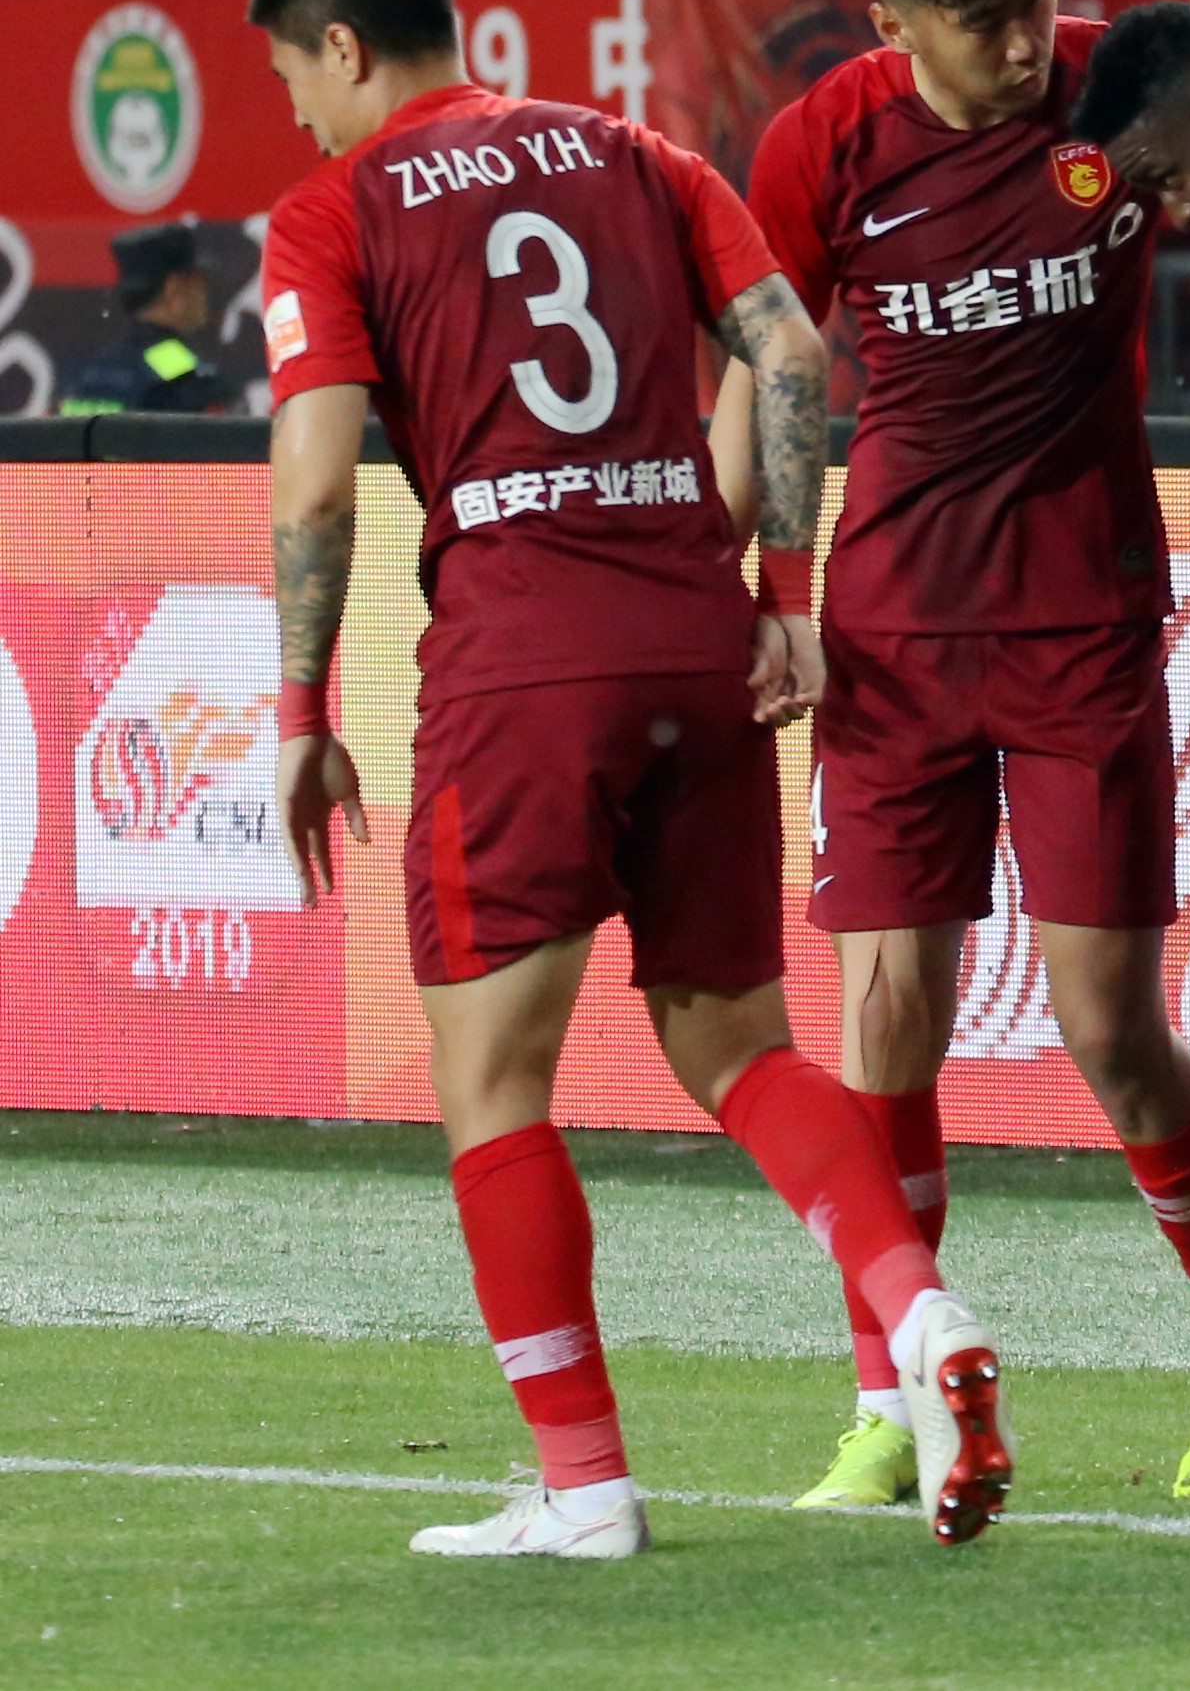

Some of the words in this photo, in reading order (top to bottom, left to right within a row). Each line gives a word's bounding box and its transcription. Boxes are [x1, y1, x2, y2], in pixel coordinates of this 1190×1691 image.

[385, 144, 517, 209] ZHAO
[517, 126, 606, 176] Y.H.
[1057, 144, 1099, 162] CFFC
[485, 211, 619, 435] 3
[450, 457, 701, 531] 固安产业新城
[130, 910, 252, 992] 2019
